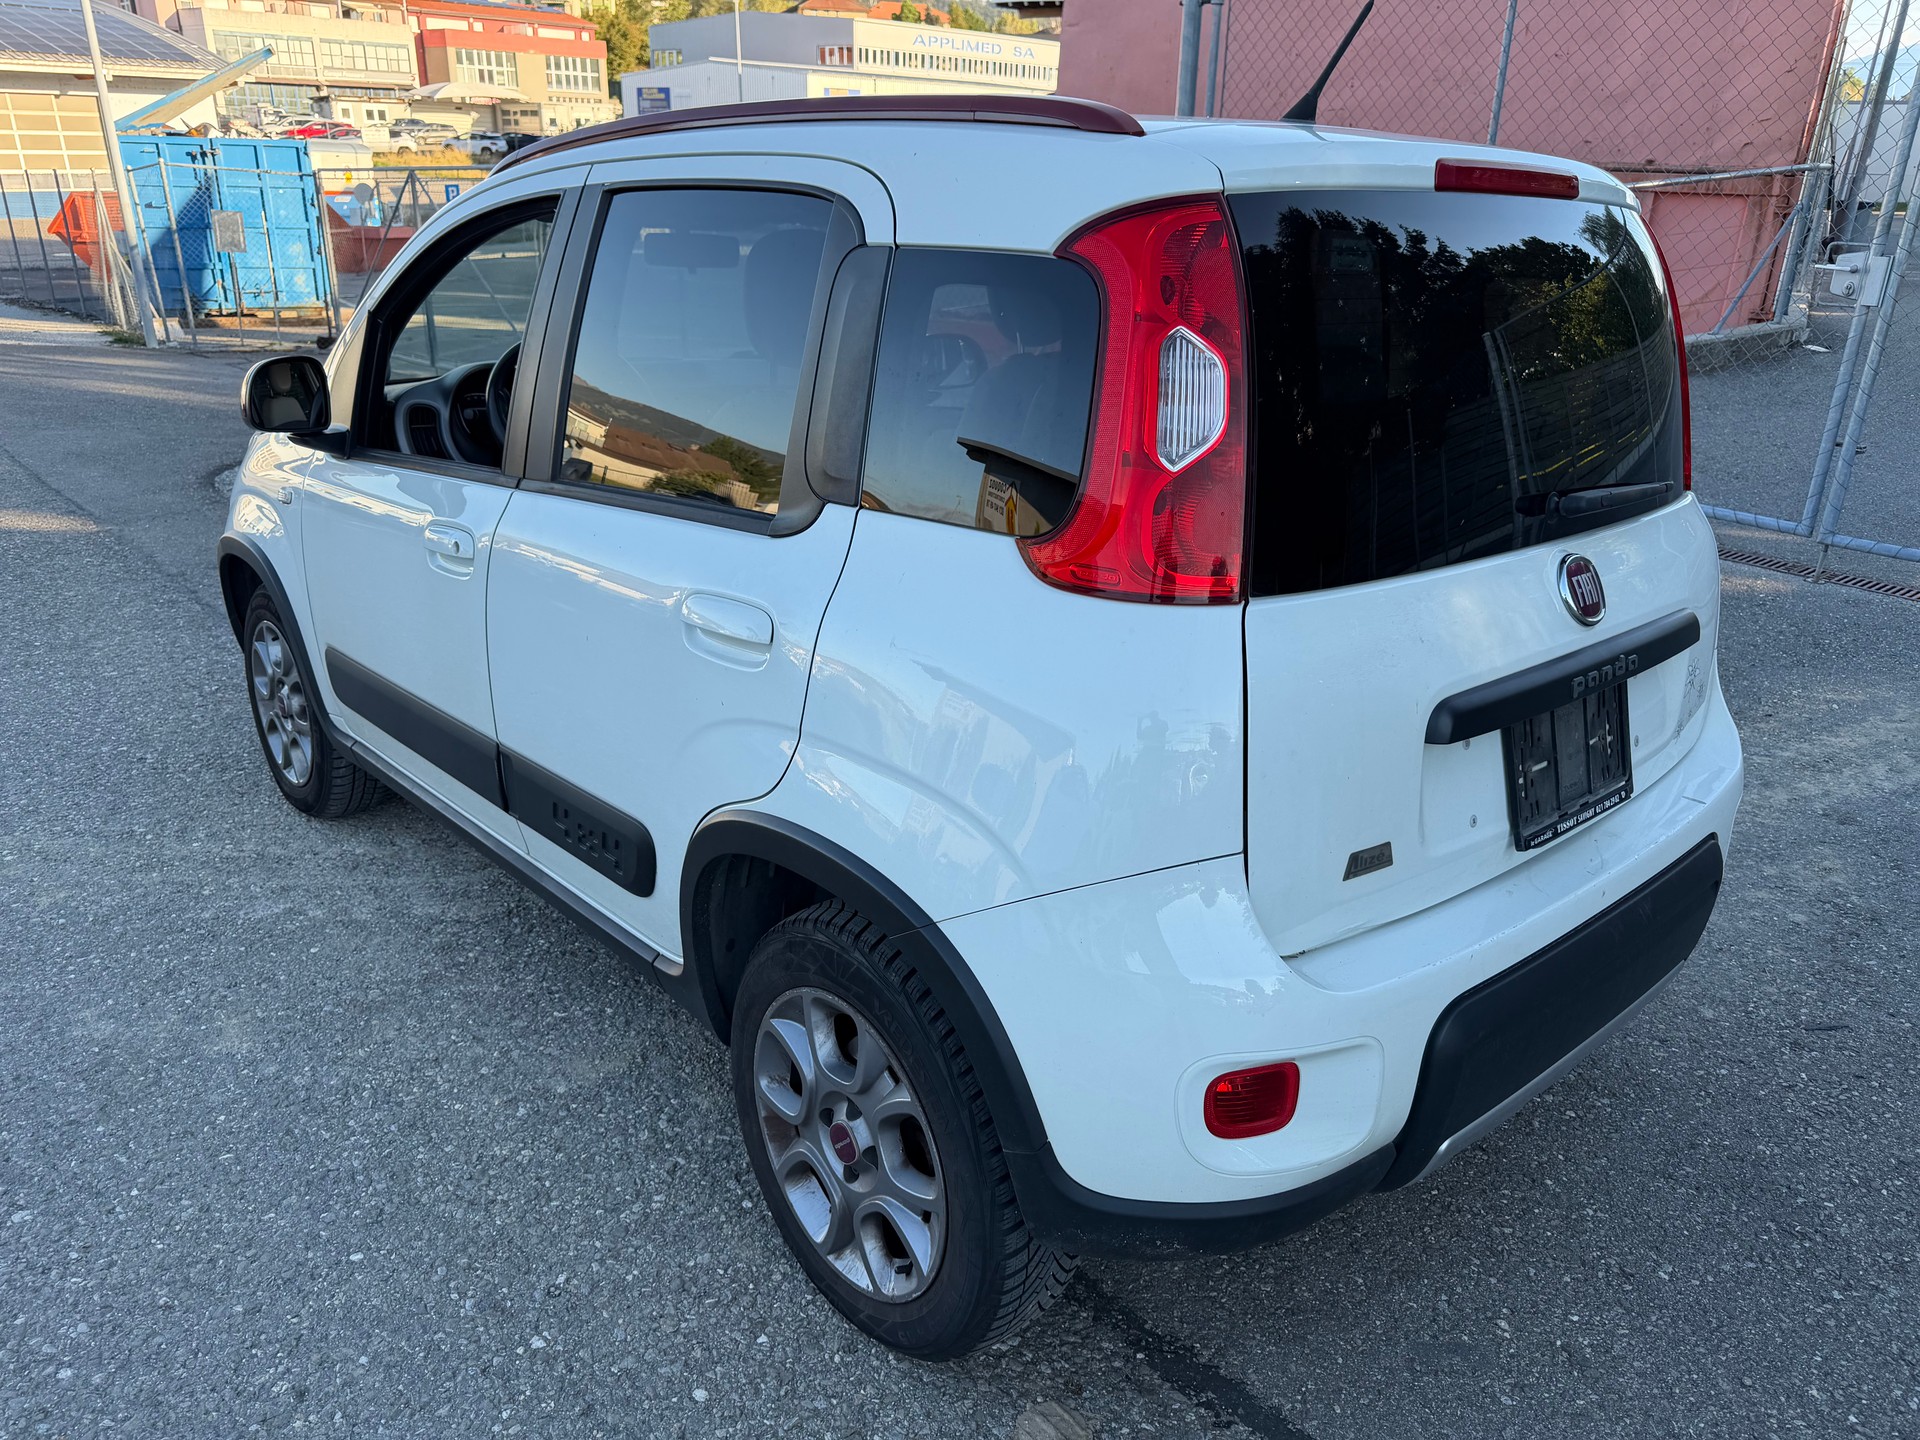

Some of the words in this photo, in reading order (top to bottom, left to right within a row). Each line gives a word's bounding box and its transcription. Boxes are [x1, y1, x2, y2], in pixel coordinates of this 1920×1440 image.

[913, 34, 1002, 56] APPLIMED
[1013, 46, 1035, 59] SA
[448, 187, 458, 200] P
[1571, 572, 1599, 608] FIAT
[1571, 654, 1639, 699] panda
[1557, 816, 1577, 833] TISSOT
